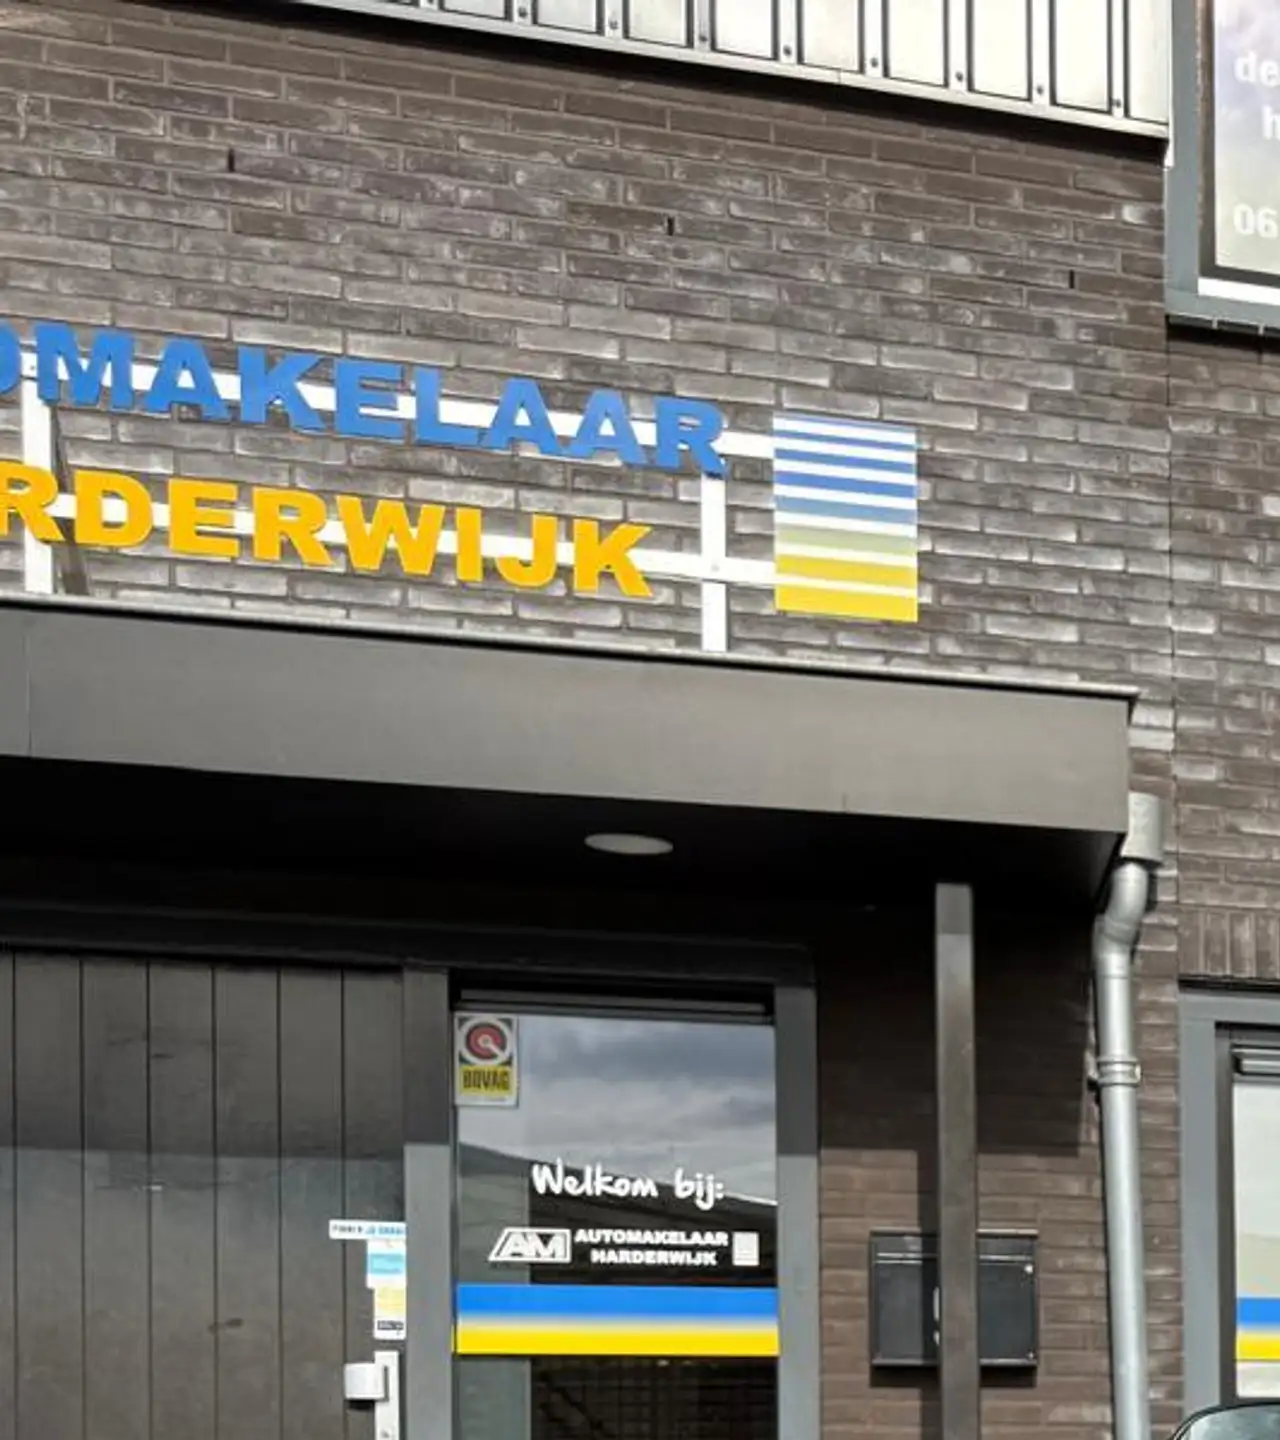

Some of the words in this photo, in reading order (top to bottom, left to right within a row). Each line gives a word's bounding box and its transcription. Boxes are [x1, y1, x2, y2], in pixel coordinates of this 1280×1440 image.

[1234, 203, 1278, 239] 06
[0, 318, 727, 474] MAKELAAR
[532, 1158, 659, 1198] Welkom
[674, 1168, 725, 1211] bij:
[574, 1229, 729, 1247] AUTOMAKELAAR
[590, 1248, 718, 1266] HARDERWIJK
